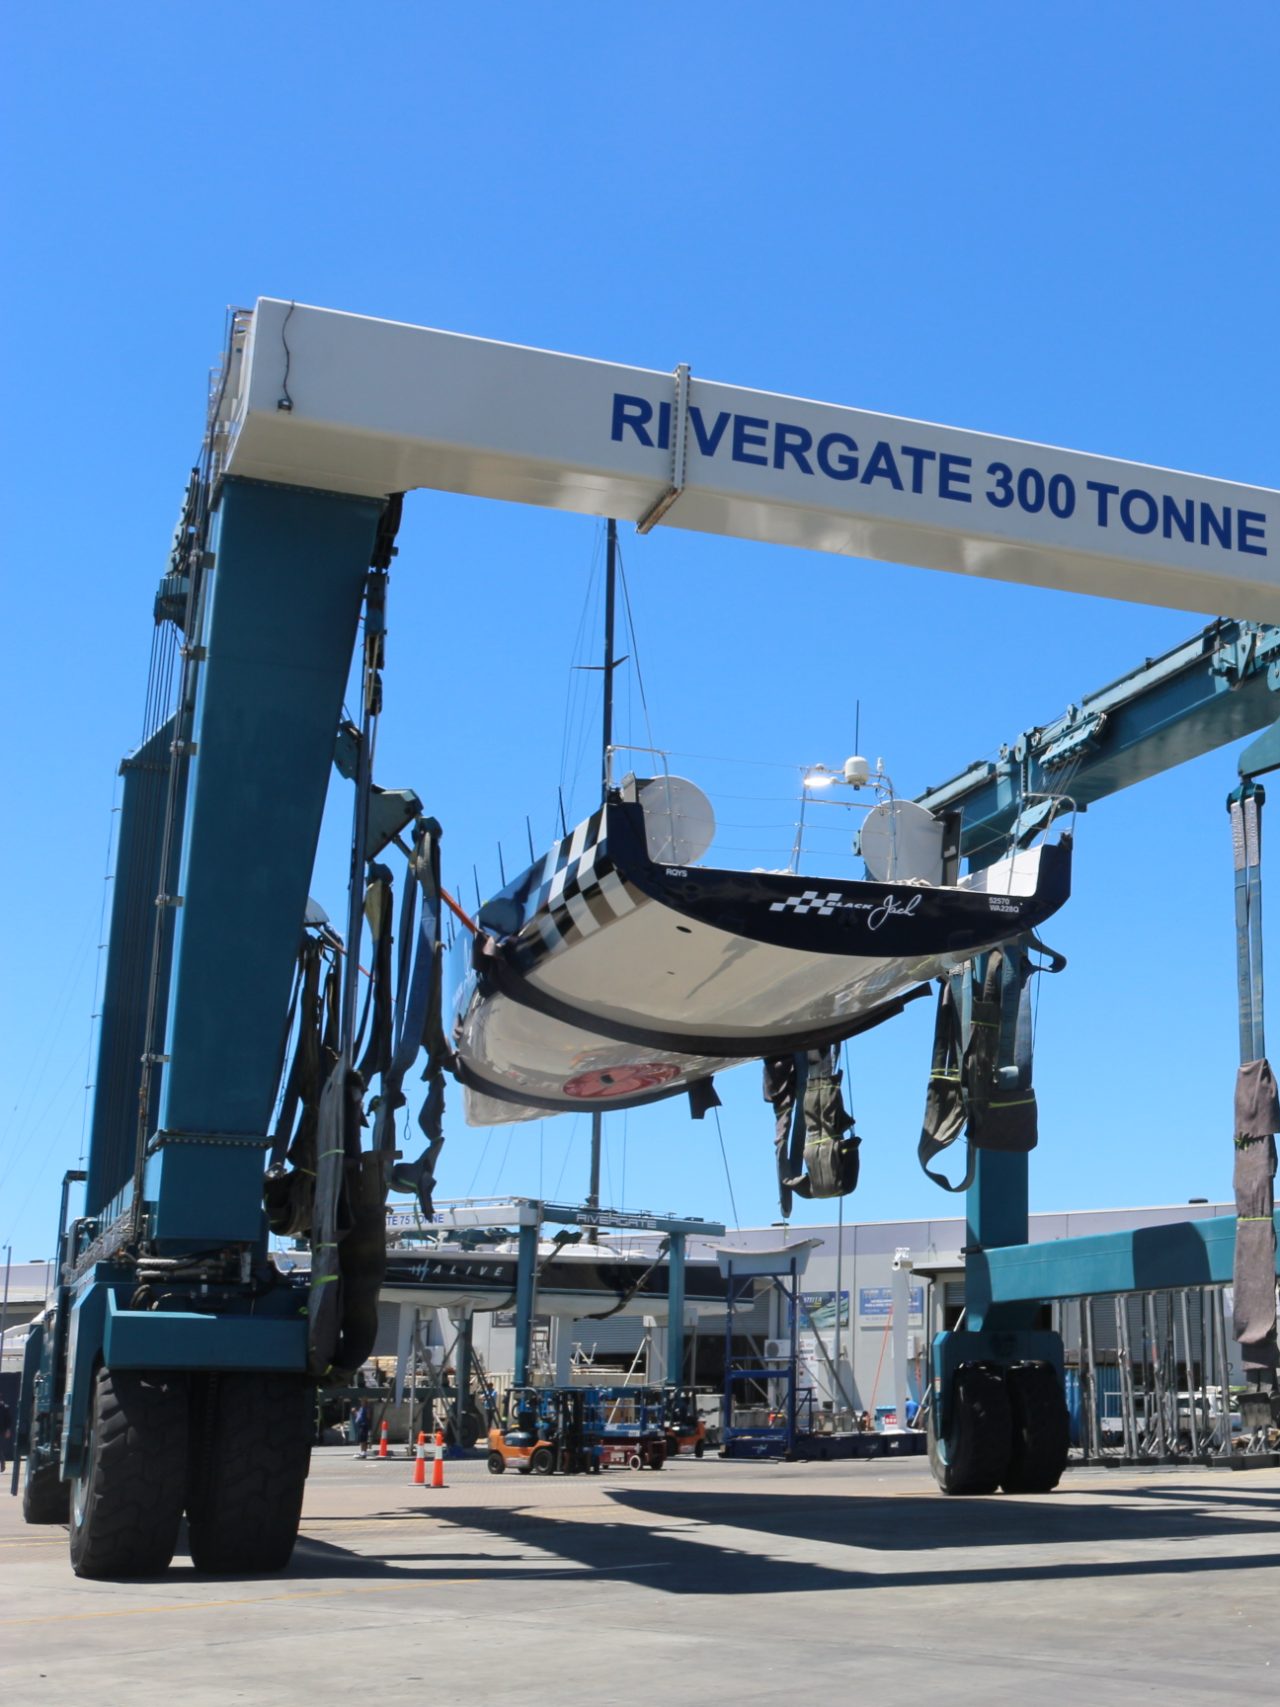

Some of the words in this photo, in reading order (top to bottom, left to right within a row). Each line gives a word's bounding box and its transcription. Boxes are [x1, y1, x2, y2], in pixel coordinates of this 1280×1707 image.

[611, 392, 973, 503] RIVERGATE
[986, 461, 1076, 520] 300
[1086, 480, 1268, 557] TONNE
[826, 900, 873, 910] BLACK
[867, 894, 922, 931] Jack
[399, 1215, 410, 1225] 75
[576, 1213, 658, 1230] RIVERGATE
[432, 1264, 505, 1278] ALIVE
